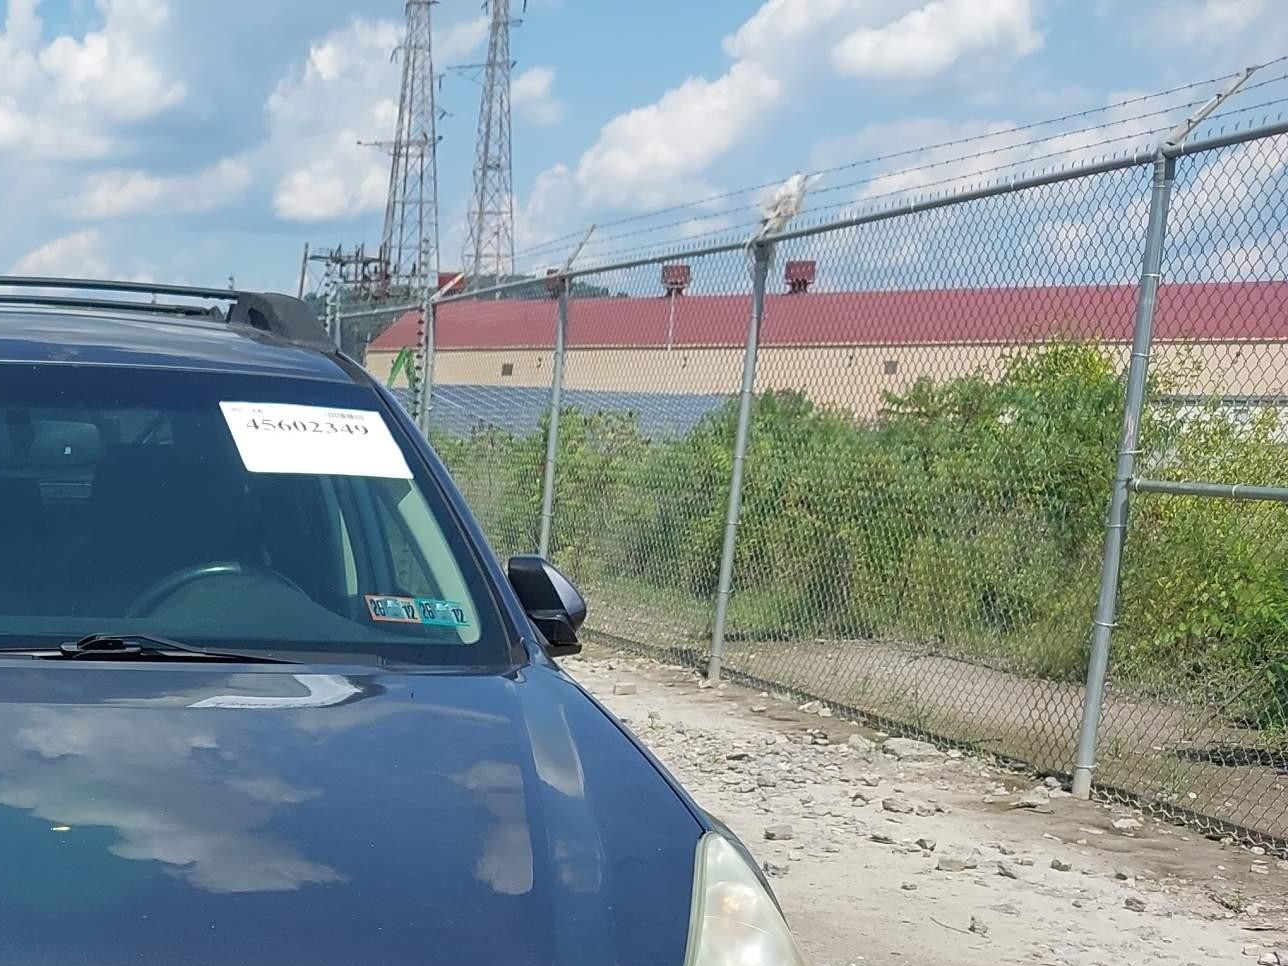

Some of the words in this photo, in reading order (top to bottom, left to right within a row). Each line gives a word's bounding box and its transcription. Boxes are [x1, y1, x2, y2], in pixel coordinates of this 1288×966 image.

[246, 418, 369, 436] 45602349
[402, 605, 418, 620] 12
[420, 603, 435, 620] 26
[451, 608, 467, 623] 12
